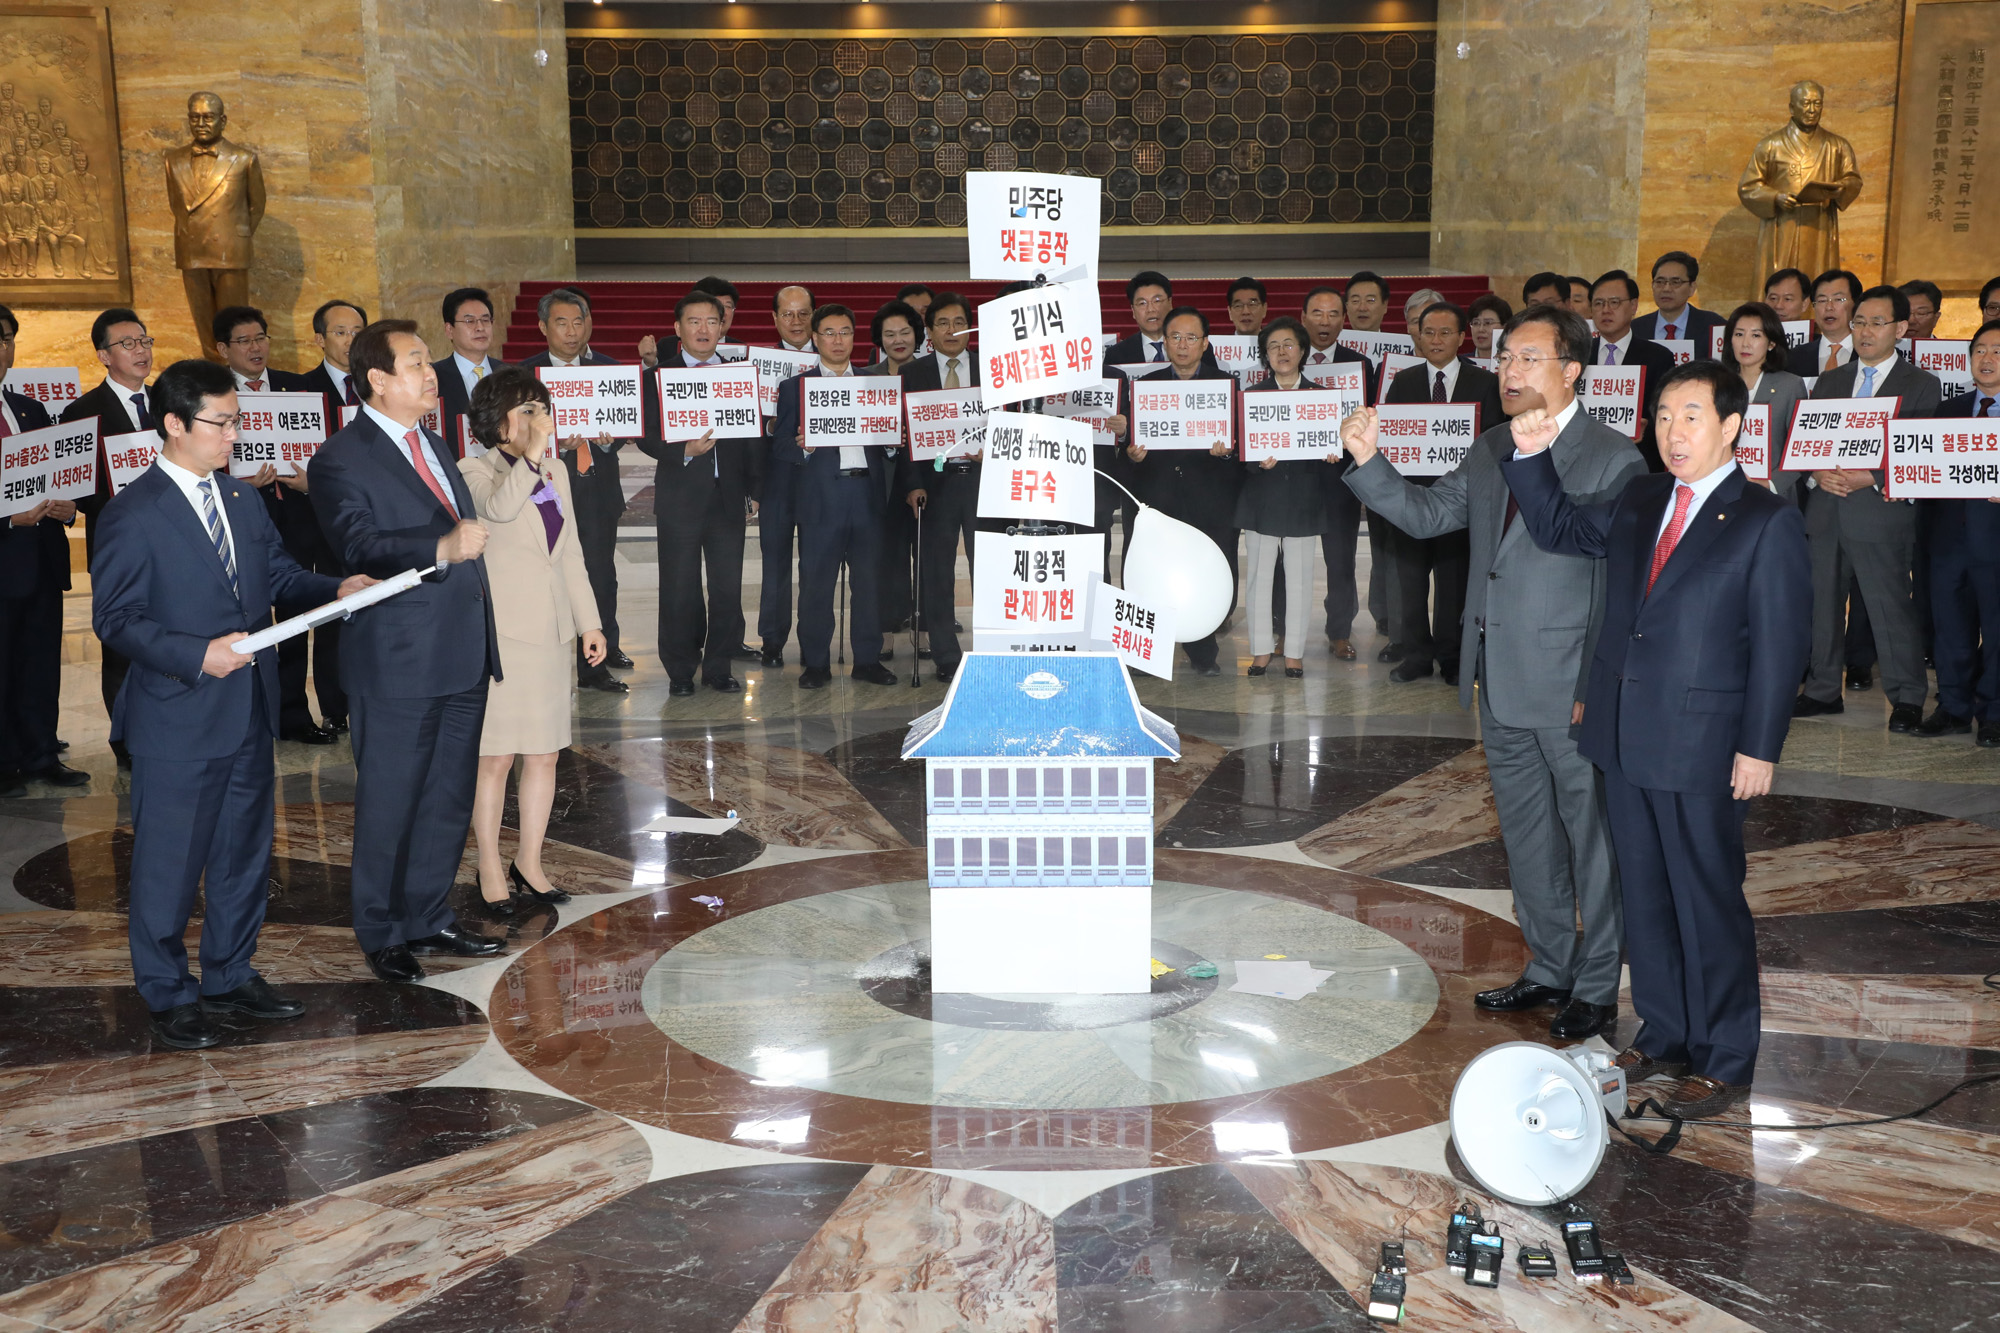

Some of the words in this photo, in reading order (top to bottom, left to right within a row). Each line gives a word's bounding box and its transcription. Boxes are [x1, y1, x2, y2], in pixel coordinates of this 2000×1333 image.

[1009, 185, 1063, 221] 민주당
[1001, 229, 1068, 265] 댓글공작
[1011, 300, 1064, 341] 김기식
[989, 343, 1059, 389] 황제갑질
[1065, 336, 1093, 373] 외유
[1919, 353, 1966, 371] 선관위에
[22, 382, 78, 402] 철통보호
[546, 380, 594, 398] 국정원댓글
[598, 379, 637, 397] 수사하듯
[666, 382, 708, 399] 국민기만
[712, 381, 754, 398] 댓글공작
[1592, 378, 1636, 396] 전원사찰
[1942, 382, 1965, 399] 대는
[809, 390, 850, 407] 헌정유린
[856, 389, 898, 406] 국회사찰
[1072, 390, 1114, 408] 여론조작
[1138, 393, 1180, 411] 댓글공작
[1185, 392, 1227, 410] 여론조작
[239, 411, 273, 431] 글공작
[279, 412, 321, 430] 여론조작
[557, 408, 590, 426] 글공작
[595, 408, 638, 425] 수사하라
[667, 410, 709, 427] 민주당을
[715, 409, 756, 426] 규탄한다
[911, 402, 958, 422] 국정원댓글
[1249, 405, 1291, 422] 국민기만
[1295, 403, 1338, 420] 댓글공작
[1798, 412, 1842, 430] 국민기만
[1844, 411, 1889, 429] 댓글공작
[809, 417, 856, 434] 문재인정권
[860, 416, 898, 433] 규탄한다
[1138, 421, 1180, 438] 특검으로
[1186, 420, 1228, 437] 일벌백계
[1379, 419, 1427, 436] 국정원댓글
[1431, 419, 1471, 436] 수사하듯
[1742, 418, 1764, 436] 사찰
[914, 429, 956, 448] 댓글공작
[961, 426, 986, 444] 수사
[991, 427, 1023, 461] 안희정
[1028, 432, 1060, 461] #me
[1066, 439, 1087, 466] too
[1249, 431, 1291, 449] 민주당을
[1296, 430, 1339, 447] 규탄한다
[1893, 433, 1933, 453] 김기식
[1942, 433, 1998, 452] 철통보호
[5, 443, 50, 470] BH출장소
[55, 432, 94, 459] 민주당은
[111, 446, 158, 469] BH출장소
[232, 443, 276, 462] 특검으로
[1735, 446, 1764, 465] 탄한다
[1790, 440, 1834, 457] 민주당을
[1837, 439, 1882, 457] 규탄한다
[4, 474, 46, 501] 국민앞에
[51, 463, 93, 489] 사죄하라
[1893, 464, 1942, 484] 청와대는
[1949, 464, 1999, 484] 각성하라
[1010, 469, 1056, 504] 불구속
[1013, 550, 1065, 583] 제왕적
[1004, 588, 1074, 622] 관제개헌
[1114, 598, 1156, 634] 정치보복
[1111, 625, 1153, 660] 국회사찰
